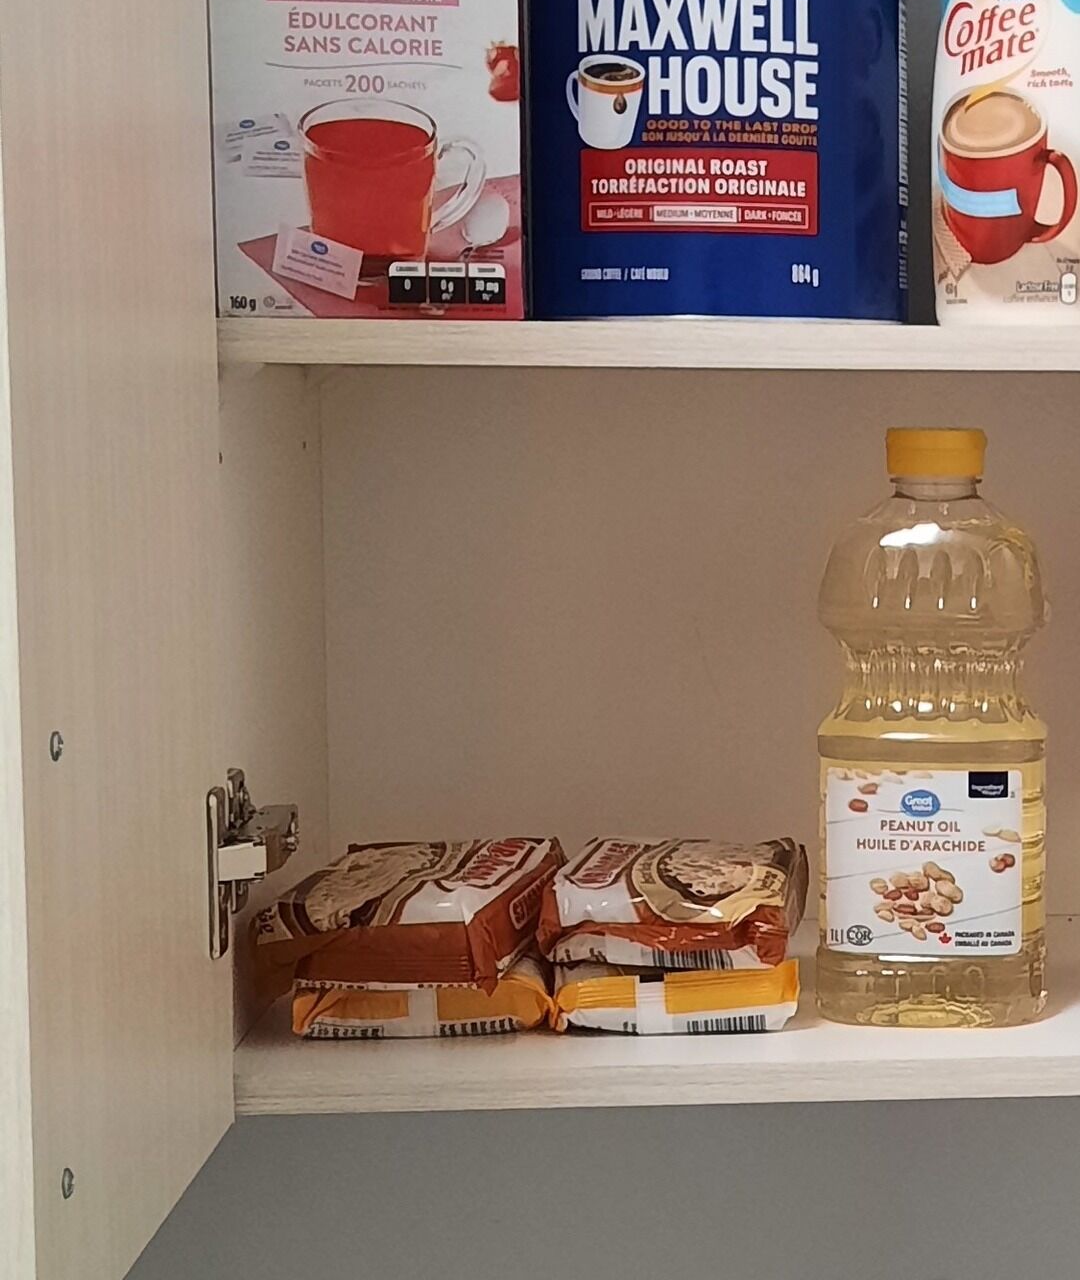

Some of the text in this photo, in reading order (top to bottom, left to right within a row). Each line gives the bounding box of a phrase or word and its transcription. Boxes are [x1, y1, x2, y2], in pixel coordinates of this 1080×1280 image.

[288, 7, 438, 33] ÉDULCORANT
[944, 1, 1036, 58] Coffee
[284, 35, 444, 57] SANS CALORIE
[960, 30, 1036, 77] mate
[345, 74, 385, 94] 200
[647, 55, 819, 121] HOUSE
[647, 120, 818, 135] GOOD TO THE LAST DROP
[642, 131, 664, 143] BON
[713, 132, 726, 144] LA
[625, 158, 768, 177] ORIGINAL ROAST
[591, 176, 806, 199] TORRÉFACTION ORIGINALE
[656, 208, 689, 219] MEDIUM
[694, 208, 734, 220] MOYENNE
[230, 295, 257, 312] 160 g
[904, 795, 934, 808] Great
[880, 820, 961, 833] PEANUT OIL
[856, 838, 986, 853] HUILE D'ARACHIDE
